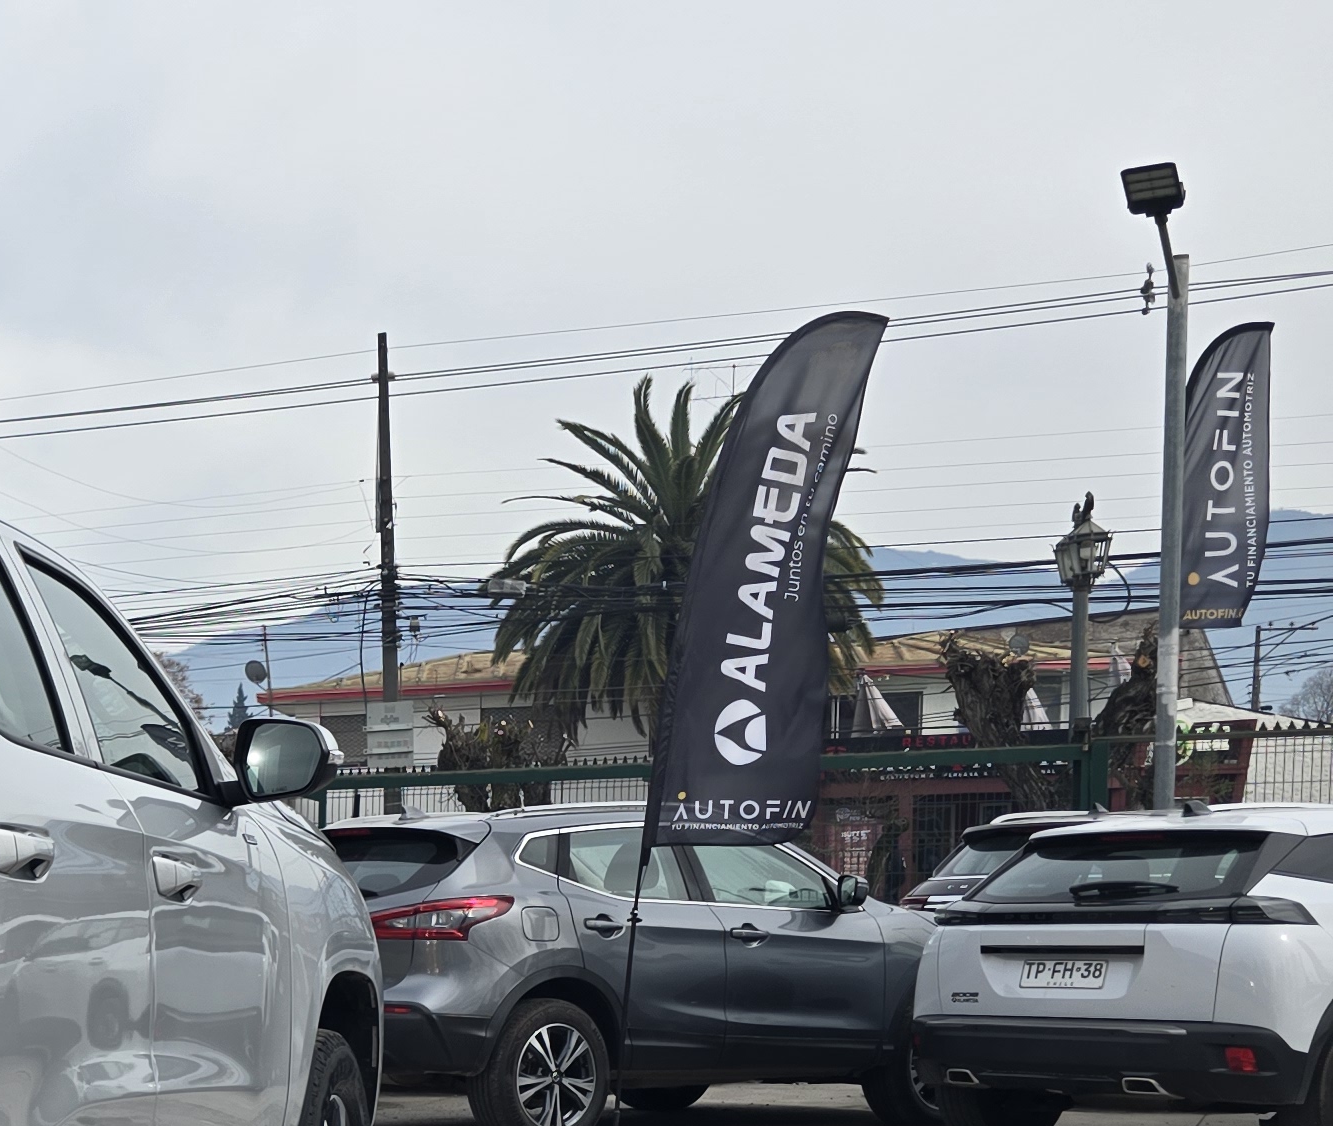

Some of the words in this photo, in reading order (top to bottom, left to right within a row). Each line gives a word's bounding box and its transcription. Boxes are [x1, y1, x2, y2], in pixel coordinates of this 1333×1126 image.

[1241, 372, 1255, 456] AUTOMOTRIZ
[784, 539, 804, 602] Juntos
[814, 413, 838, 483] camino
[1205, 372, 1244, 588] AUTOFIN
[1243, 461, 1257, 567] FINANCIAMIENTO
[720, 412, 818, 692] ALAMEDA
[1246, 571, 1256, 588] TU
[673, 799, 812, 822] AUTOFIN
[684, 823, 759, 831] FINANCIAMIENTO
